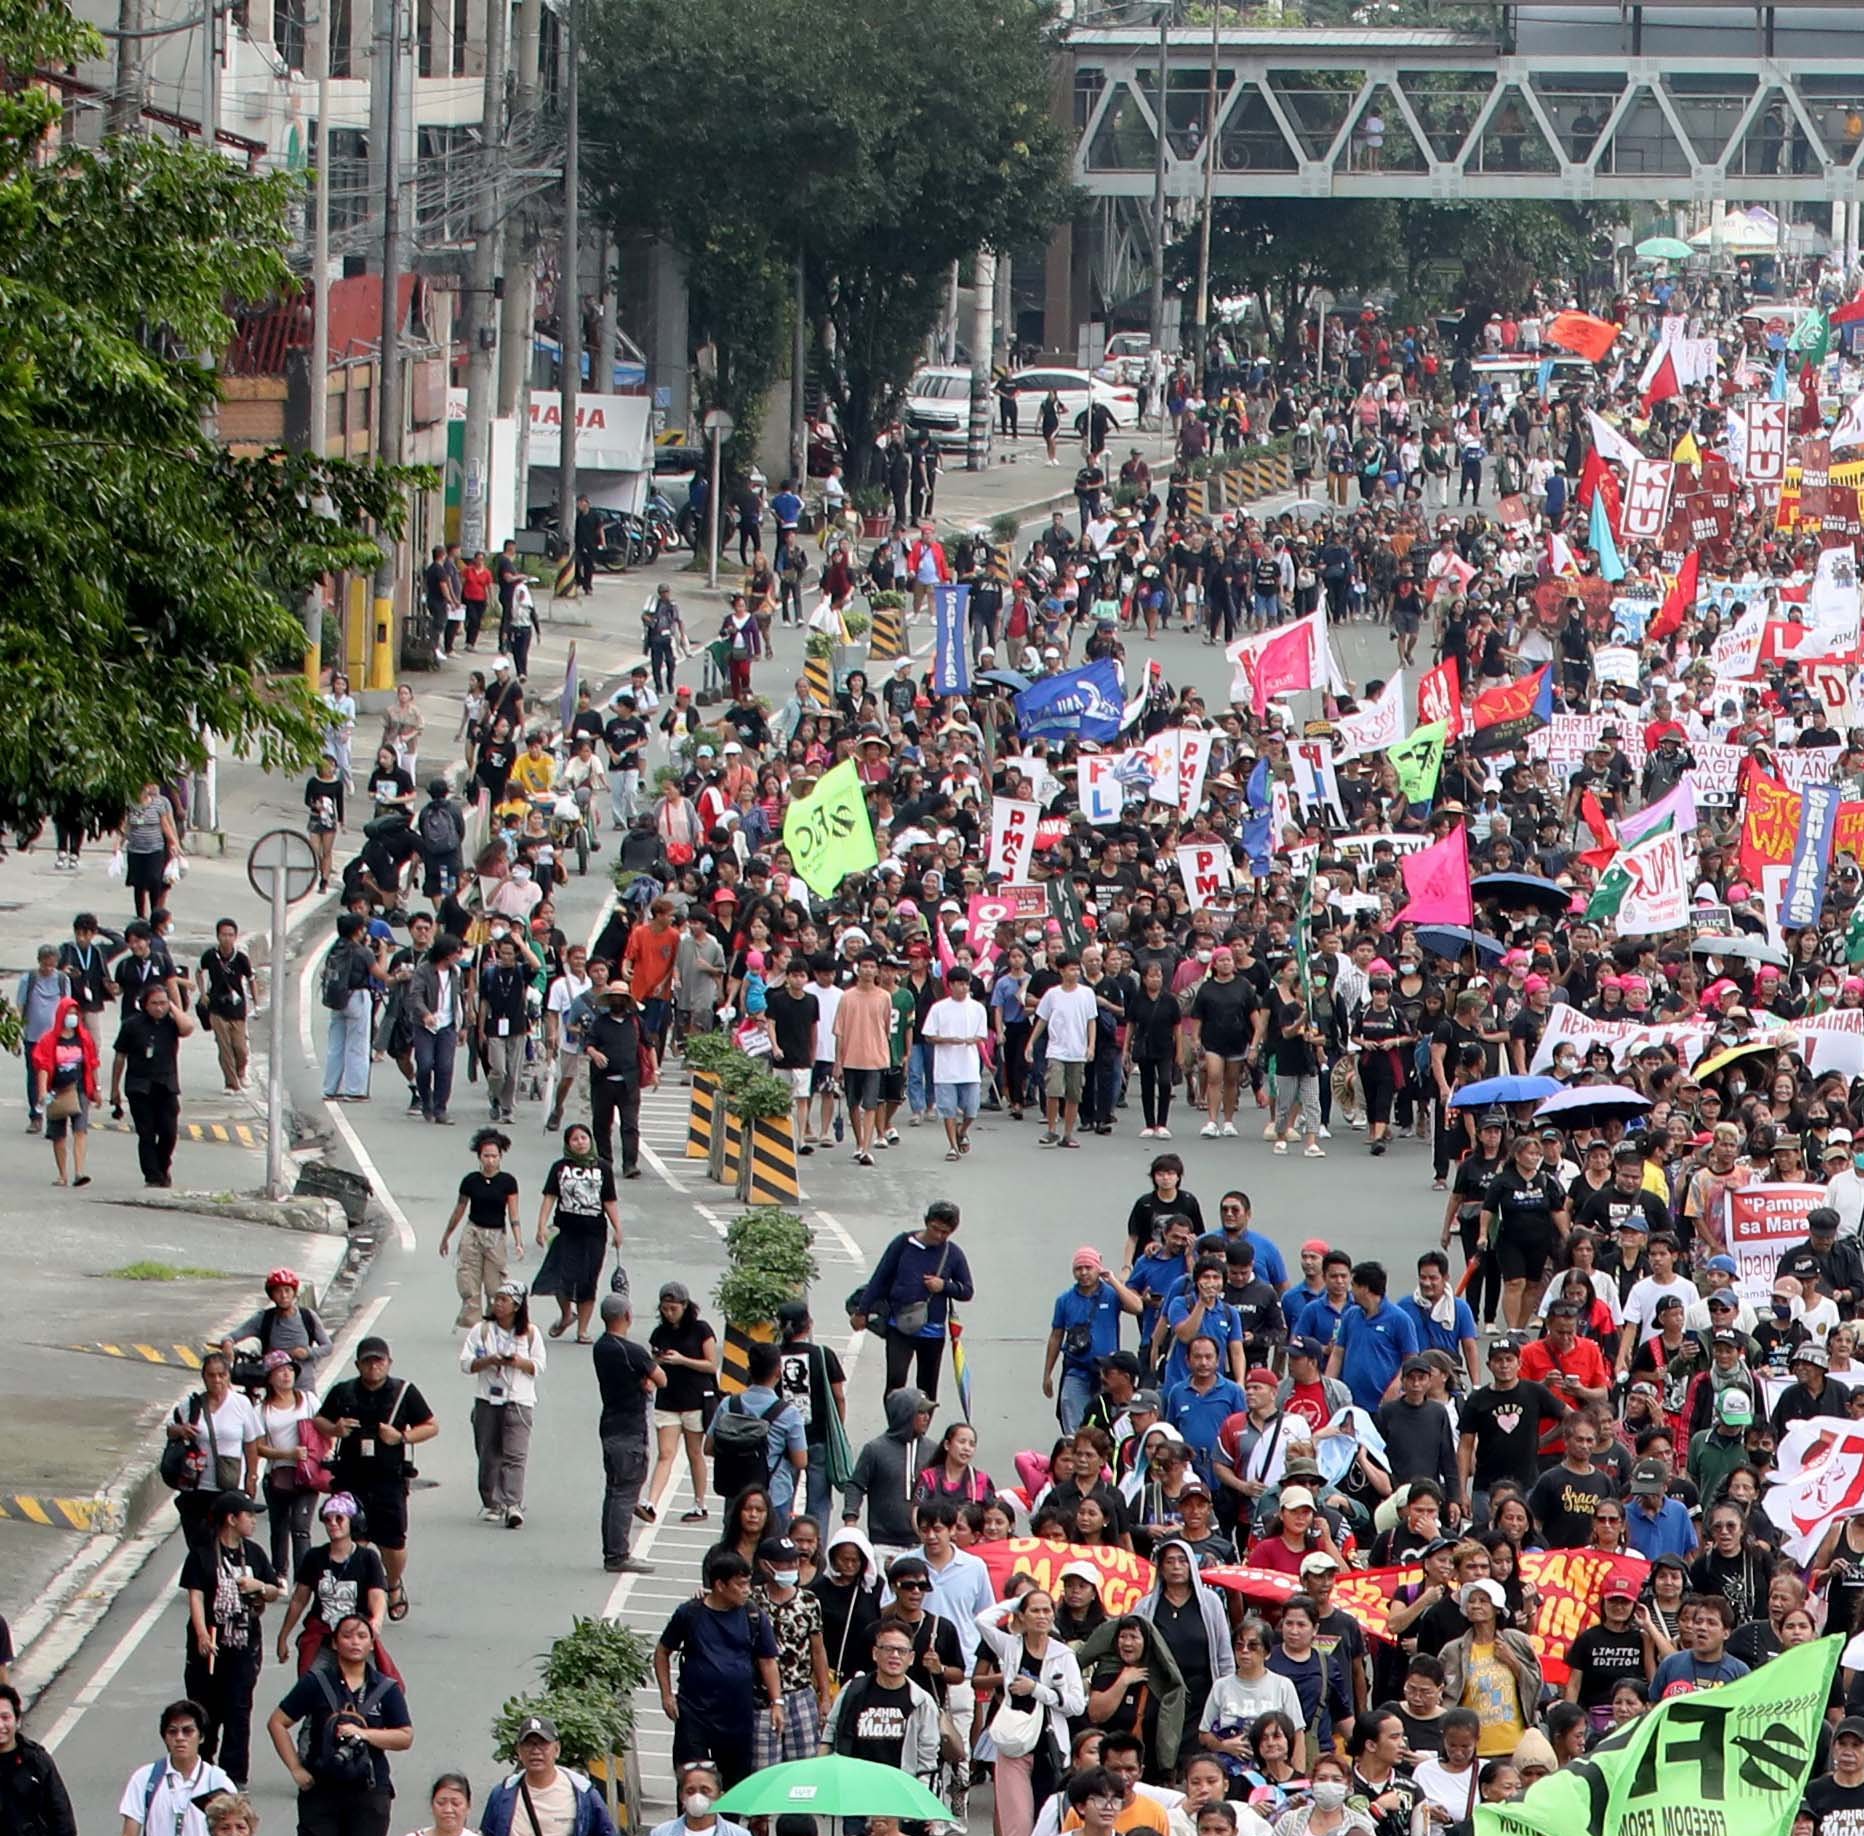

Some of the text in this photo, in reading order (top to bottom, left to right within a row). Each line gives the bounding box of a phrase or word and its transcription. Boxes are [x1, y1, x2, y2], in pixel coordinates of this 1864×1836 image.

[1746, 402, 1786, 479] KMU
[1627, 462, 1669, 535] KMU
[560, 1165, 604, 1182] ACAB
[1592, 1647, 1641, 1658] LIMITED
[1592, 1656, 1640, 1667] EDITION
